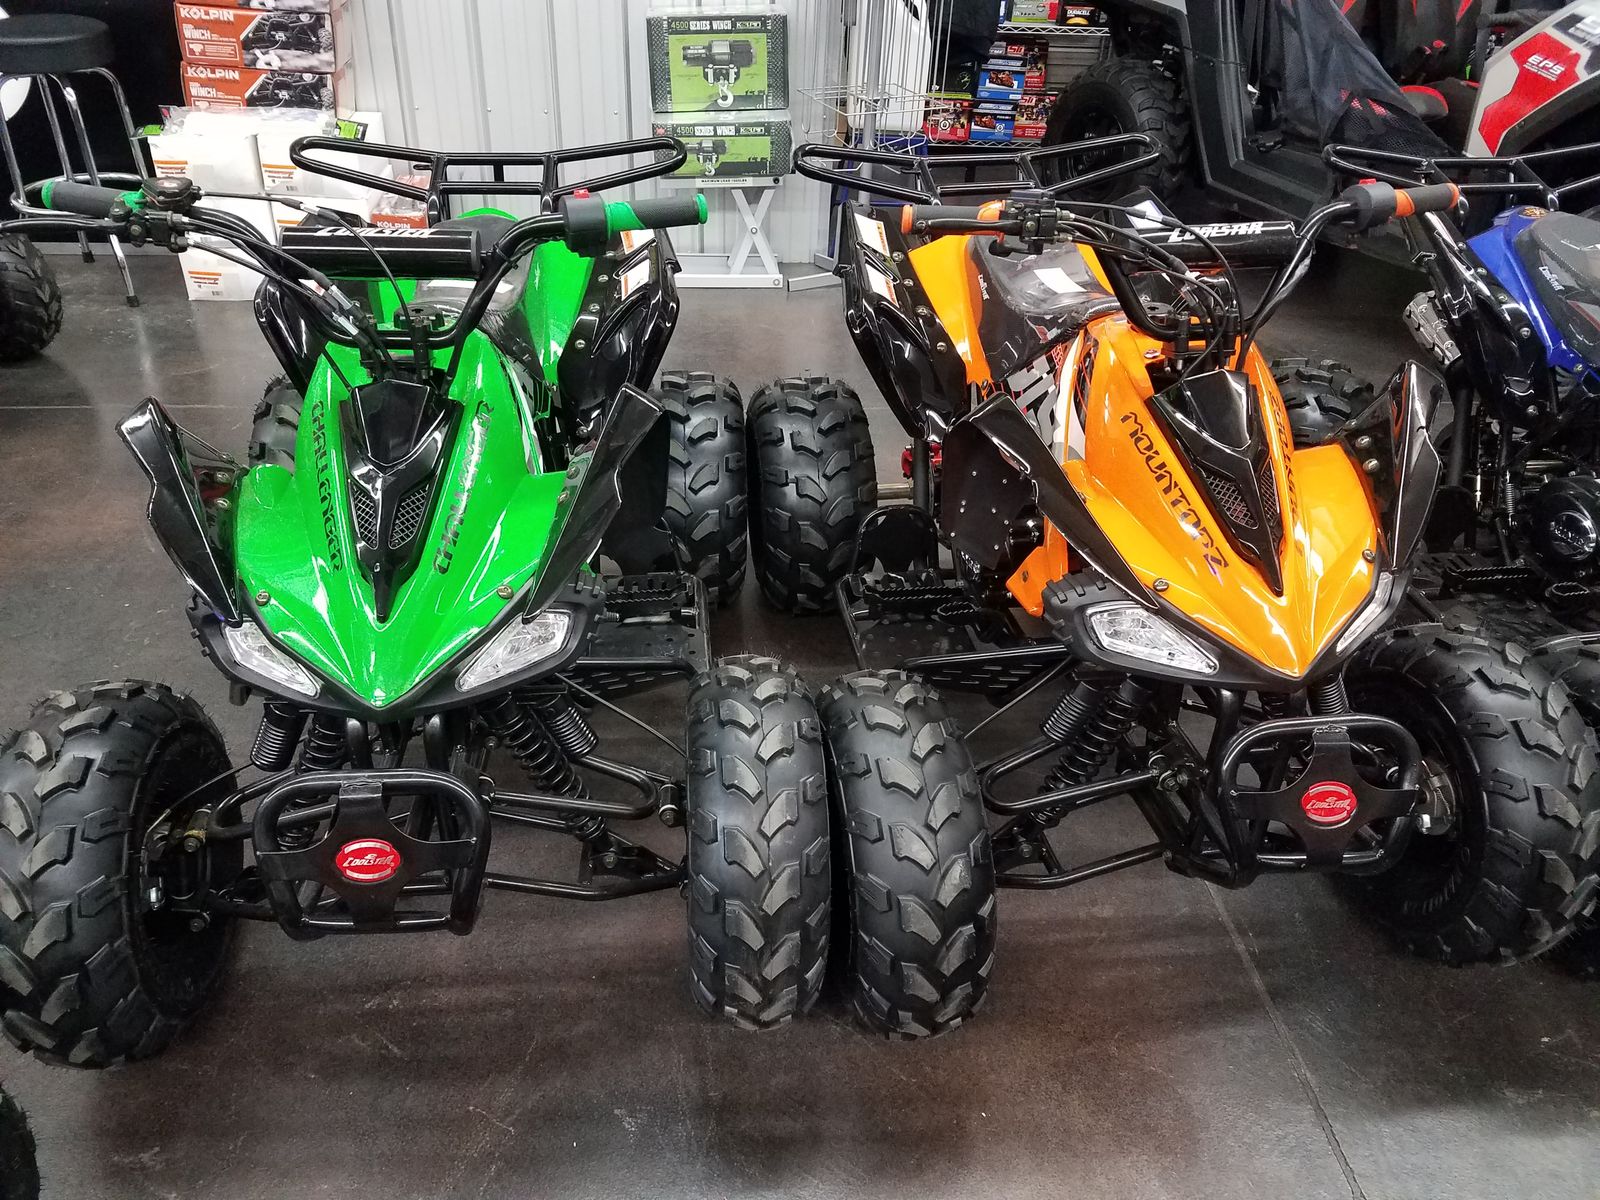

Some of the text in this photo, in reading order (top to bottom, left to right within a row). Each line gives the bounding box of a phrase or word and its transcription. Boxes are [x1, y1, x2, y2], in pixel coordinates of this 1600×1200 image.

[180, 8, 234, 21] KOLPIN
[671, 20, 731, 30] 4500 SERIES WINCH
[183, 28, 211, 40] WINCH
[1527, 54, 1565, 75] EPS
[187, 66, 240, 80] KOLPIN
[189, 86, 217, 97] WINCH
[676, 126, 694, 134] 4500
[377, 221, 410, 229] KOLPIN
[311, 400, 343, 572] CHALLENGER
